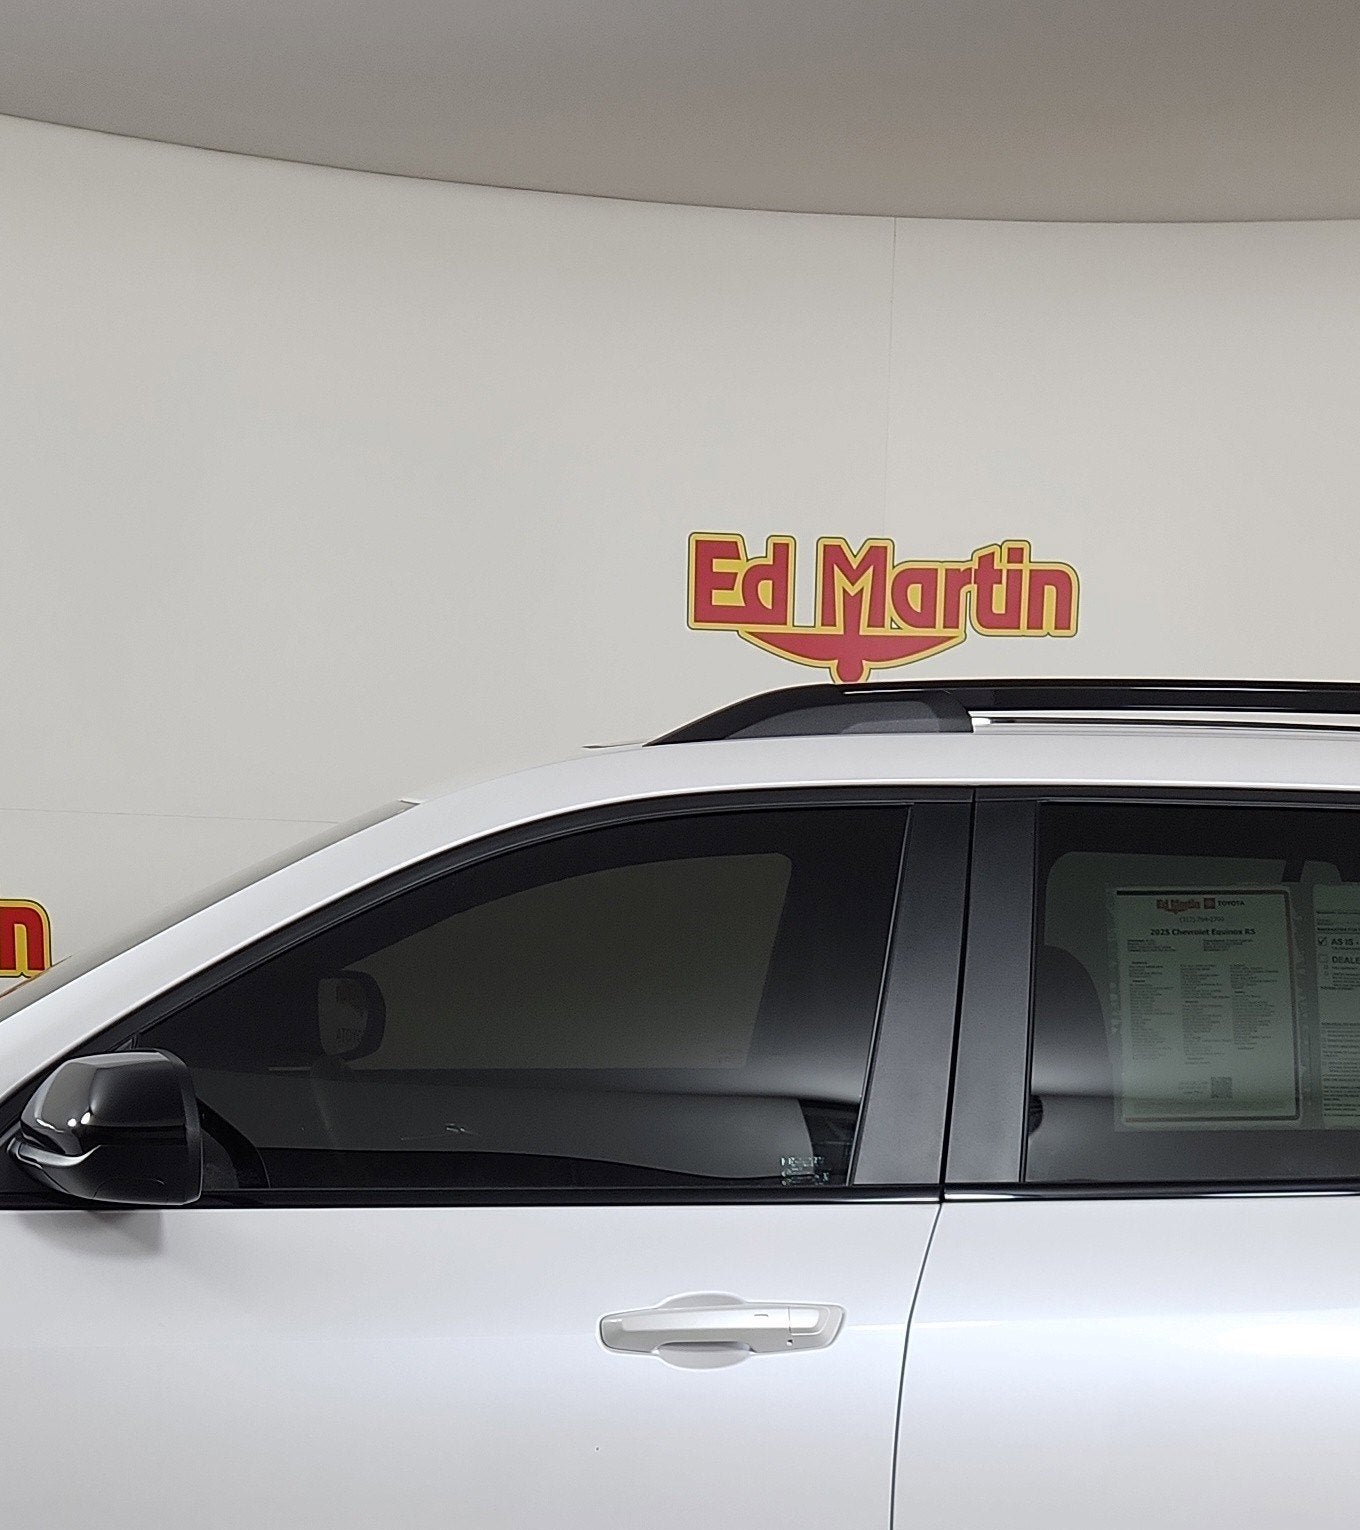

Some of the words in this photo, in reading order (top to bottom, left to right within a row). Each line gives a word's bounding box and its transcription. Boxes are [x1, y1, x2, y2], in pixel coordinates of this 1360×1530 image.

[691, 536, 792, 628] Ed
[818, 539, 1076, 633] Martin
[1150, 928, 1171, 936] 2025
[1172, 928, 1209, 936] Chevrolet
[1211, 928, 1243, 937] Equinox
[1331, 938, 1343, 946] AS
